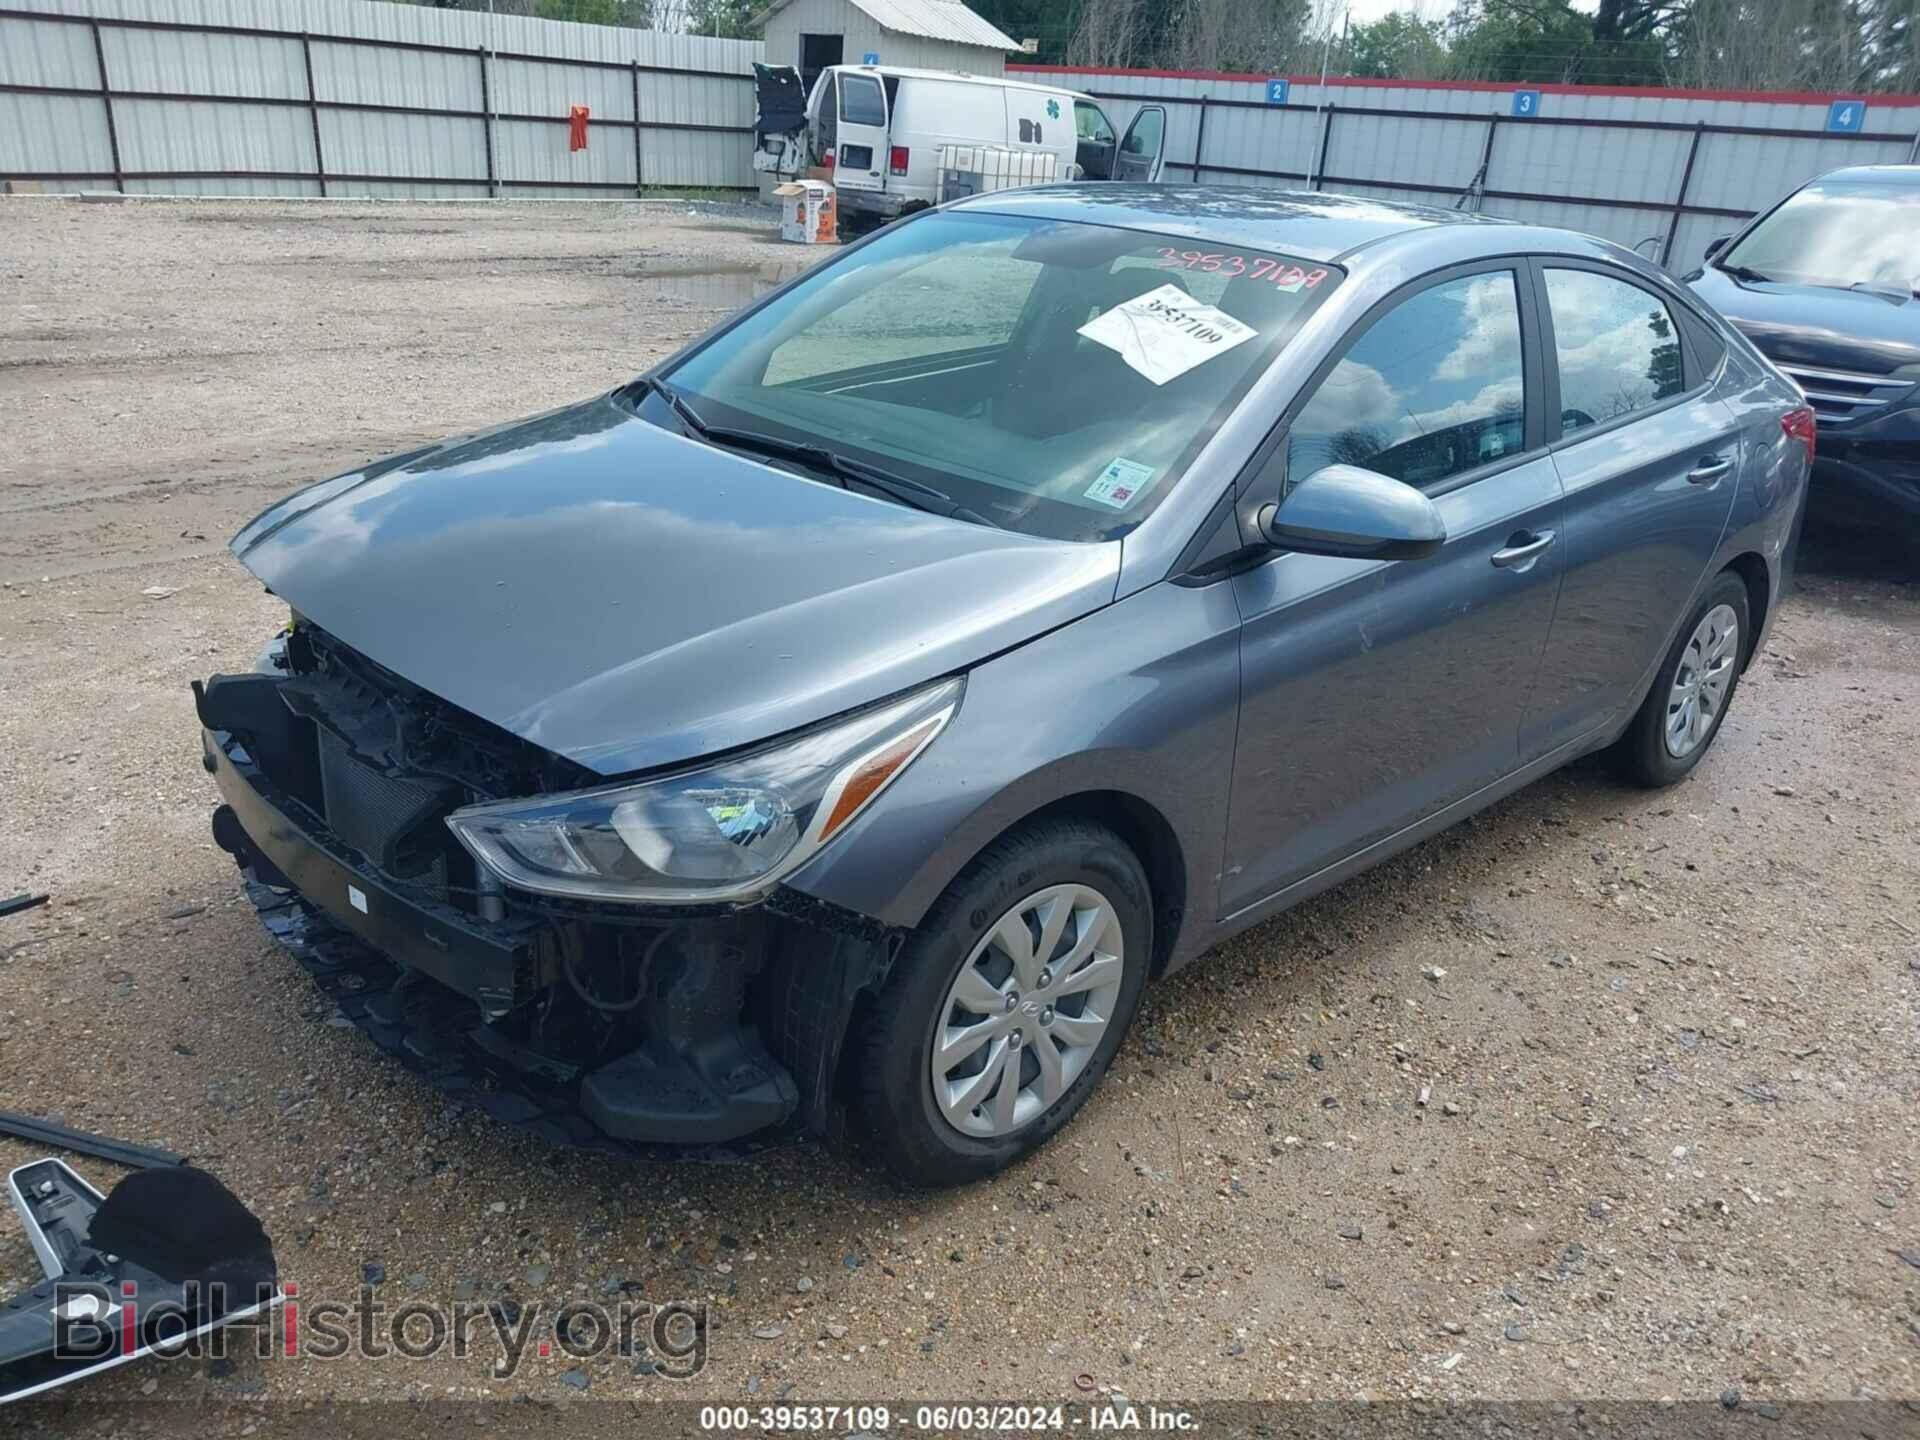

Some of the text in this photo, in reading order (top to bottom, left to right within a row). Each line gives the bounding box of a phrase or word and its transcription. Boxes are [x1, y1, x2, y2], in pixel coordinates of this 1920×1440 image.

[1273, 84, 1281, 99] 2
[1520, 95, 1530, 112] 3
[1838, 106, 1851, 126] 4
[1157, 247, 1328, 288] 39537109
[1140, 299, 1223, 344] 39537109
